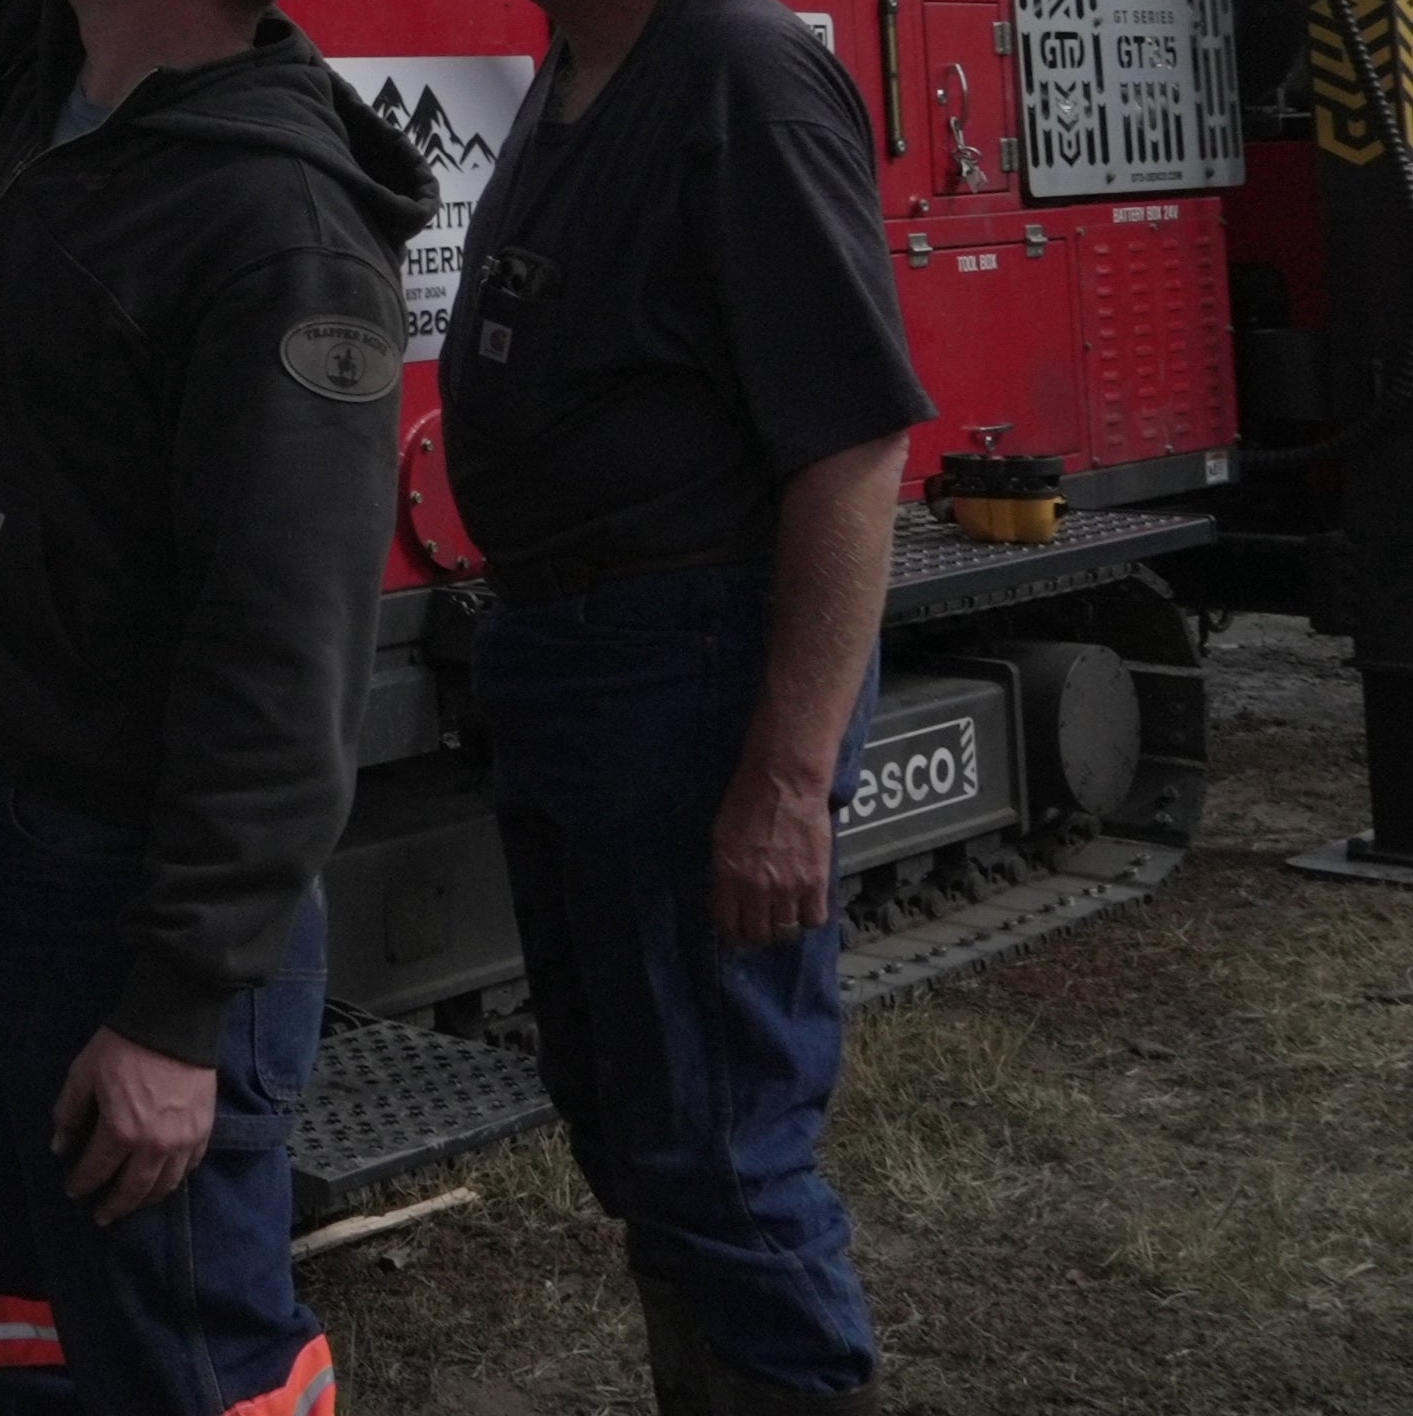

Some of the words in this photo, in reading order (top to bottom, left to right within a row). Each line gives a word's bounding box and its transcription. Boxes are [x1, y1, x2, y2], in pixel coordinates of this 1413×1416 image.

[1113, 10, 1129, 24] GT
[1132, 10, 1175, 24] SERIES
[1117, 36, 1177, 69] GT35
[1112, 206, 1145, 224] BATTERY
[1146, 204, 1162, 221] BOX
[957, 255, 979, 273] TOOL
[980, 253, 998, 271] BOX
[839, 747, 956, 824] esco
